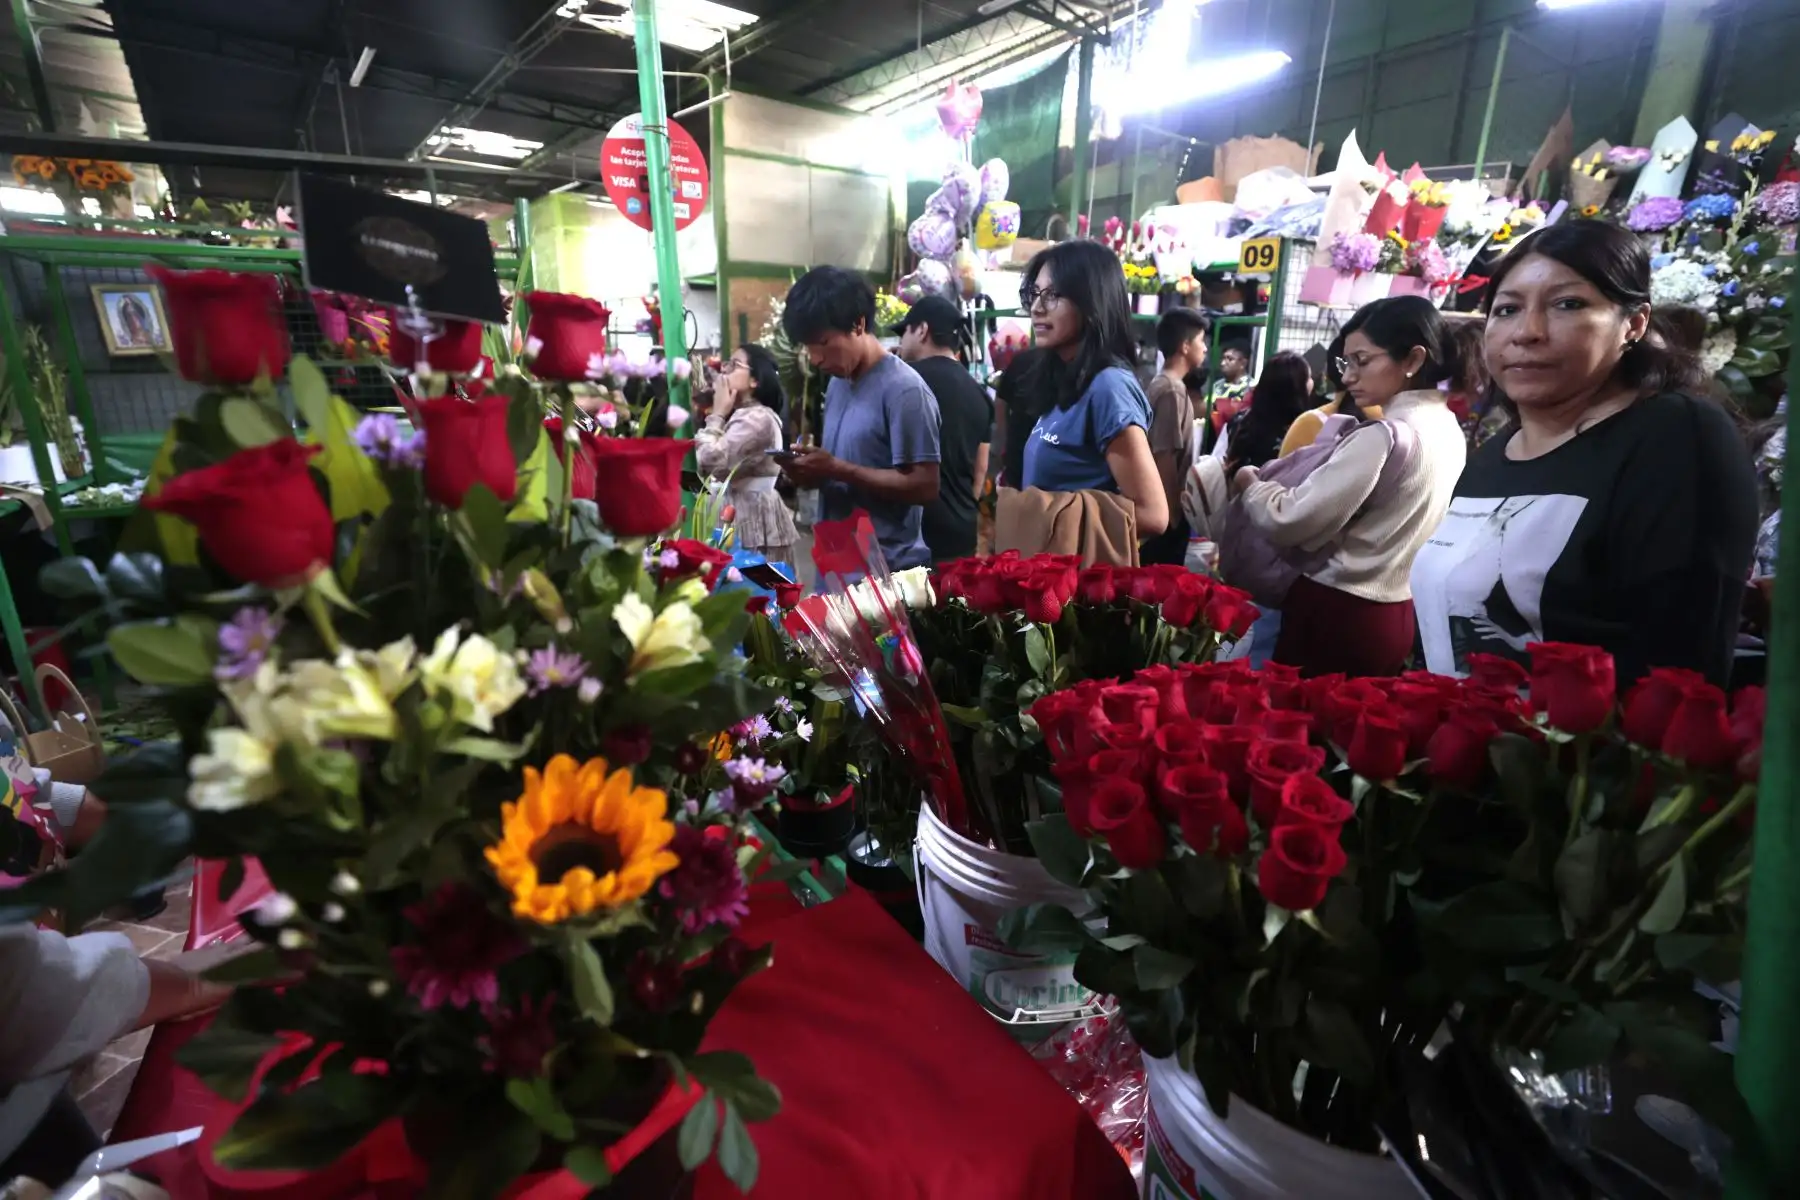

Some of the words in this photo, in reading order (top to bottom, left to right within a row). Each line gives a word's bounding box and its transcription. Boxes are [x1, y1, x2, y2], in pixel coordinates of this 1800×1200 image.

[621, 147, 646, 157] Acept
[671, 155, 690, 163] odas
[624, 158, 648, 168] tarjet
[610, 175, 636, 188] VISA
[1244, 244, 1274, 268] 09
